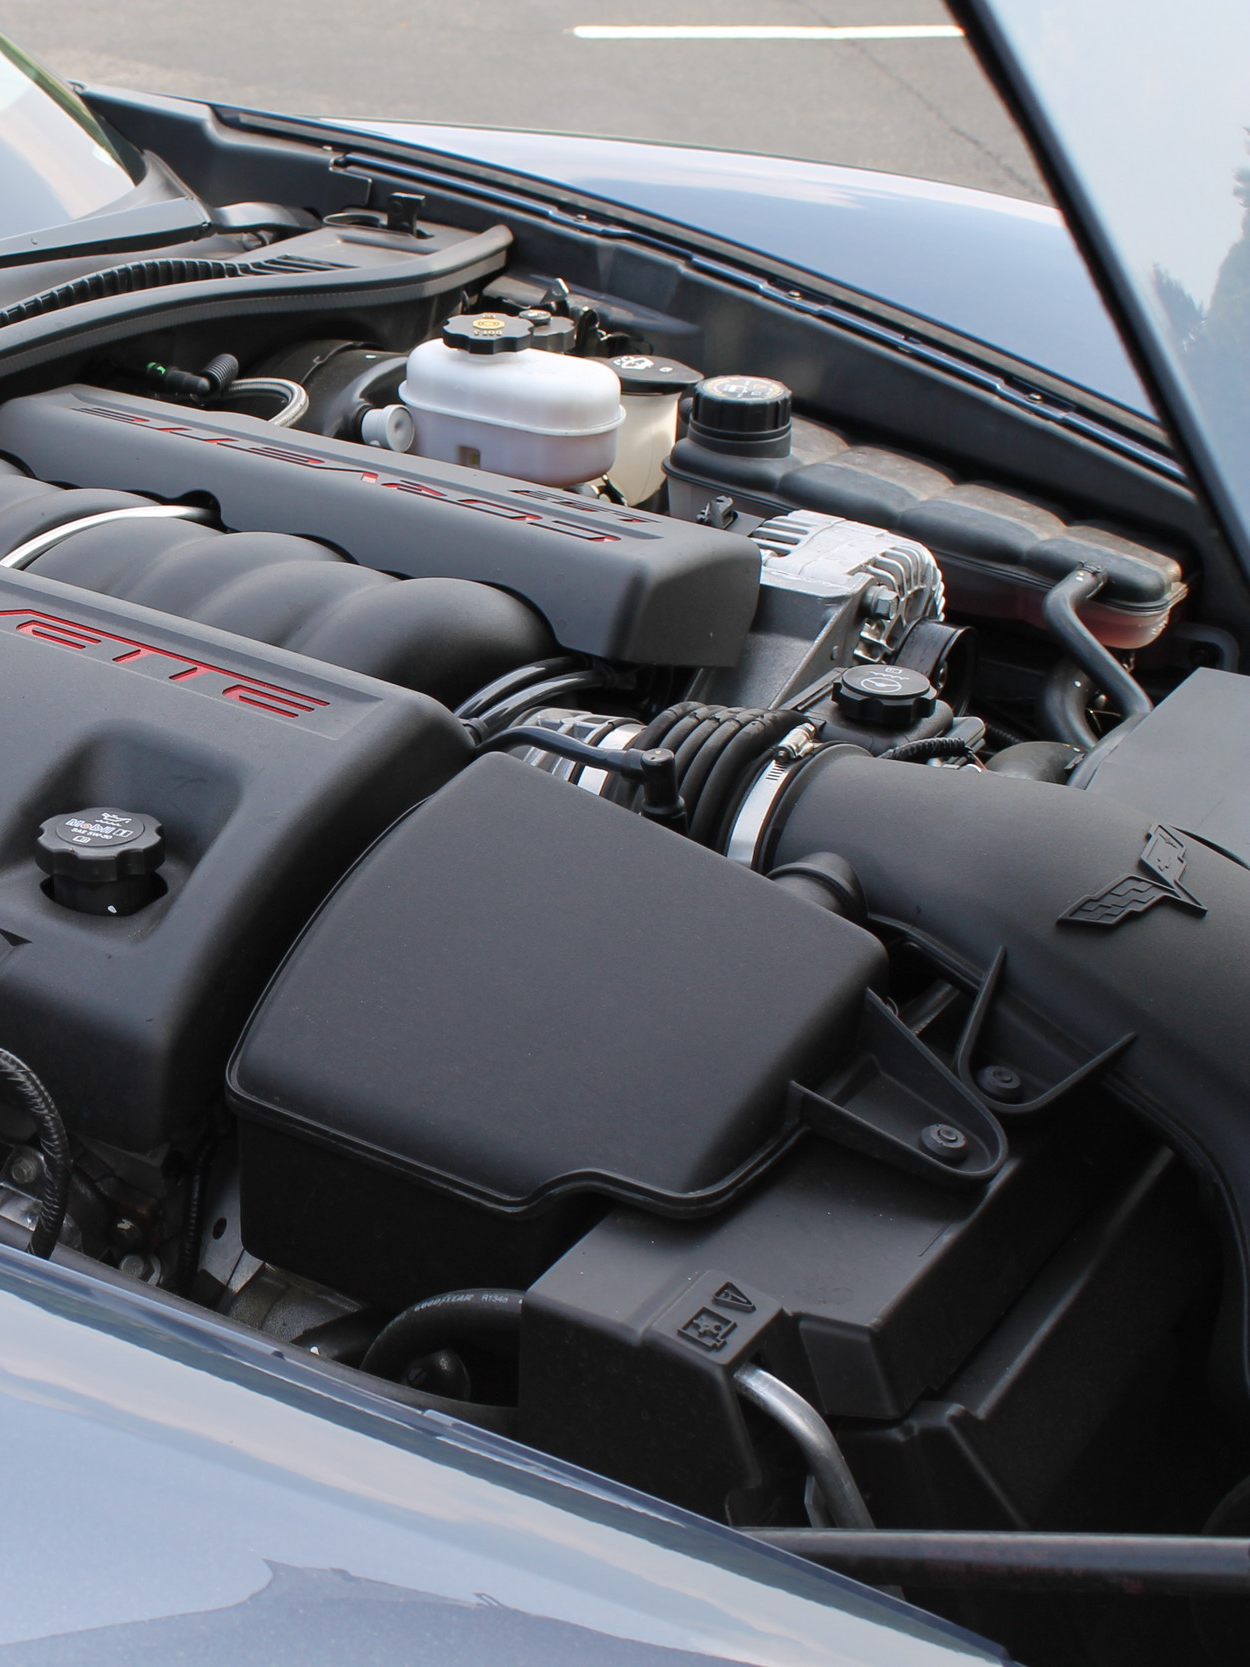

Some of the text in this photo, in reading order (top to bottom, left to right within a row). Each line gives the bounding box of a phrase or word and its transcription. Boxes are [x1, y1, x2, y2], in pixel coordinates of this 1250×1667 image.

[69, 406, 622, 543] CORVETTE
[65, 818, 116, 834] Mobil
[414, 1294, 474, 1312] GOODYEAR
